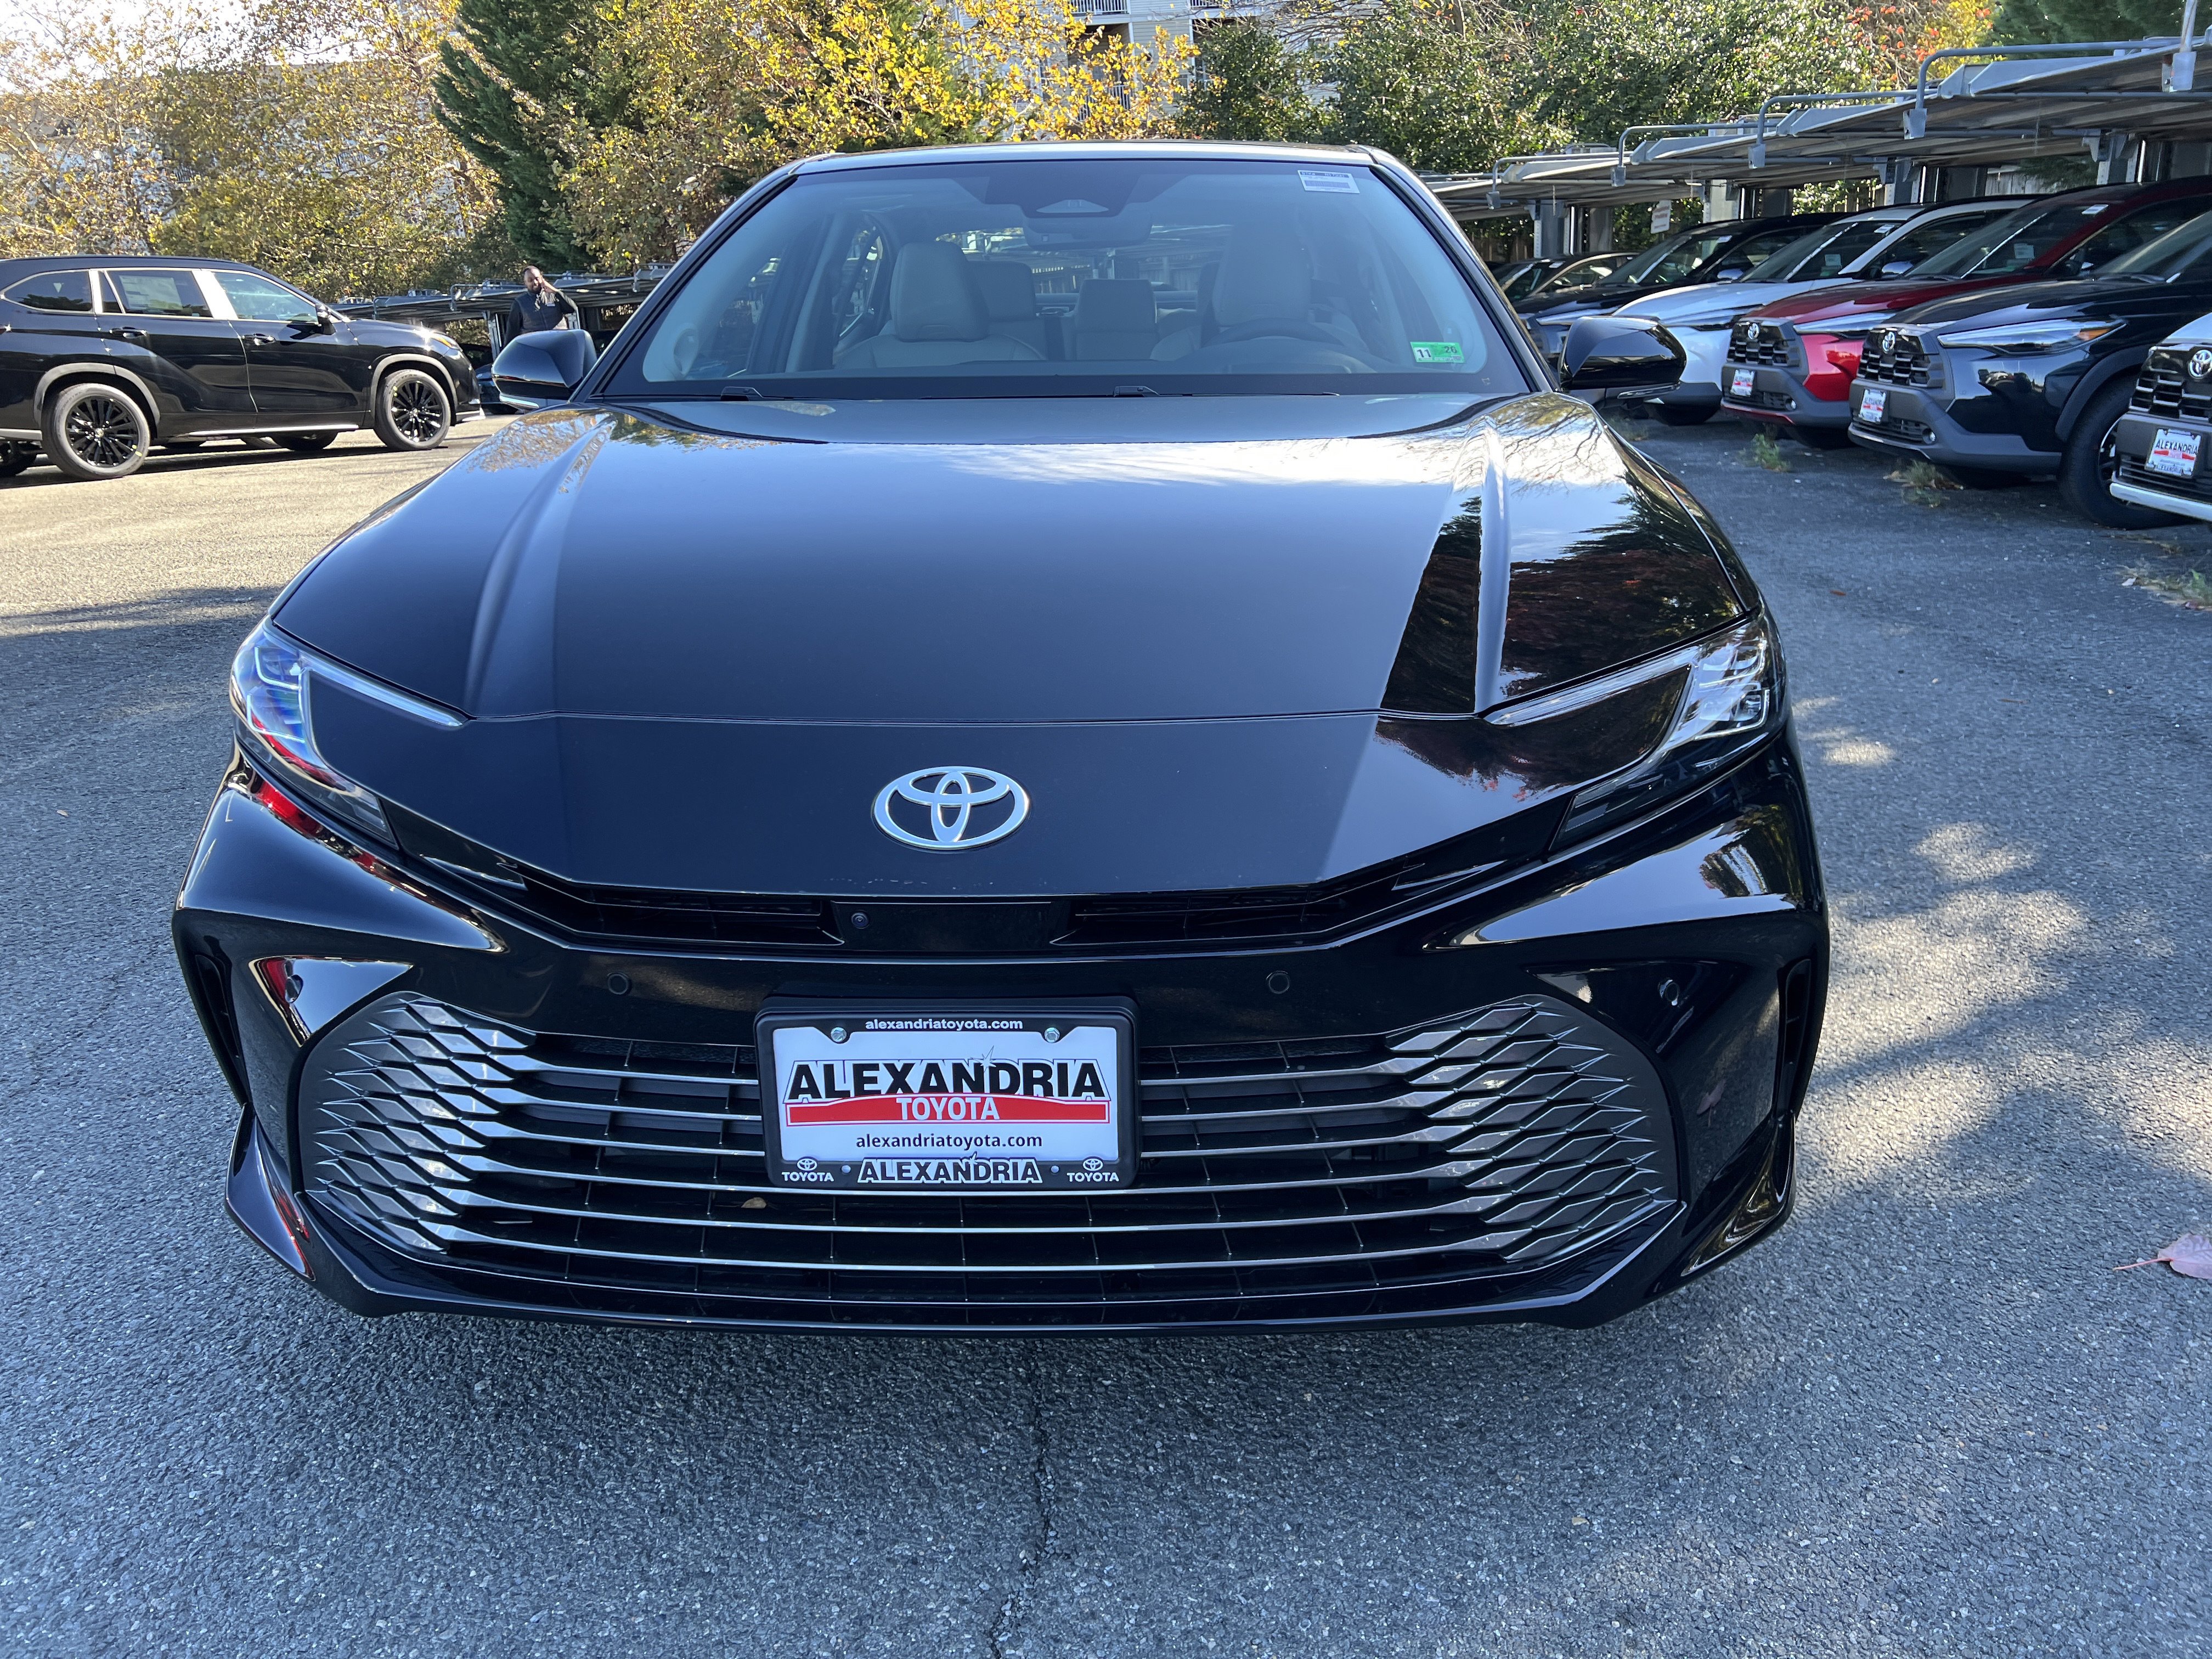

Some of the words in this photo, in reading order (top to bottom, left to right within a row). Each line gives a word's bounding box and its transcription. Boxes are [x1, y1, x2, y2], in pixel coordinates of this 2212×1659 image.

[1417, 349, 1431, 358] 11
[2155, 439, 2198, 454] ALEXANDRIA
[865, 1018, 1023, 1031] alexandriatoyota.com
[787, 1061, 1106, 1100] ALEXANDRIA
[896, 1097, 1000, 1120] TOYOTA
[856, 1133, 1042, 1151] alexandriatoyota.com
[781, 1171, 834, 1182] TOYOTA
[857, 1159, 1042, 1183] ALEXANDRIA
[1066, 1172, 1119, 1182] TOYOTA
